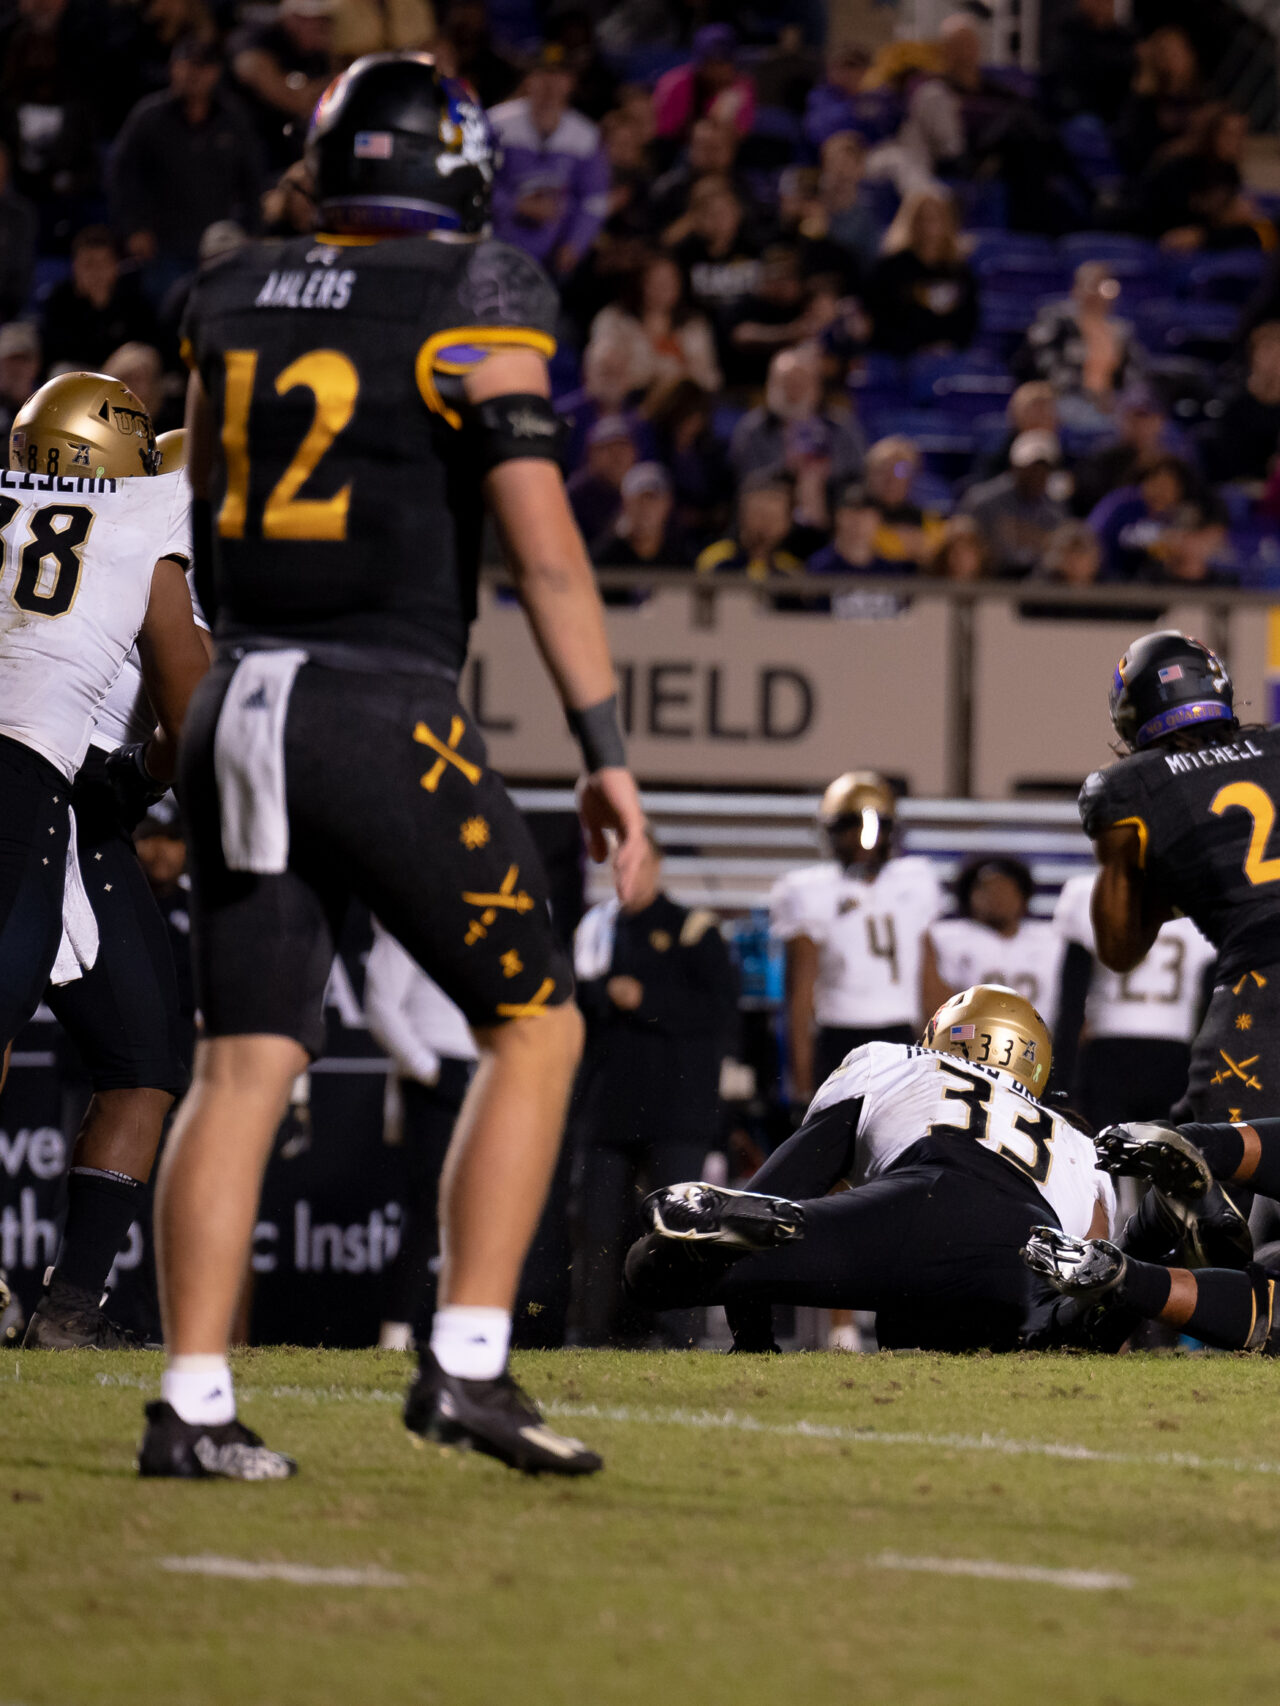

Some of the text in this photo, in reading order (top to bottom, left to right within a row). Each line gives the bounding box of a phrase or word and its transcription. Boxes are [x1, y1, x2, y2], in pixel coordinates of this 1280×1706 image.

[255, 270, 357, 309] AHLERS
[217, 350, 361, 540] 12
[0, 494, 97, 621] 8
[612, 660, 817, 744] IELD
[1165, 706, 1222, 726] QUARTER
[1164, 740, 1263, 775] MITCHELL
[868, 912, 900, 984] 4
[928, 1059, 1056, 1187] 33
